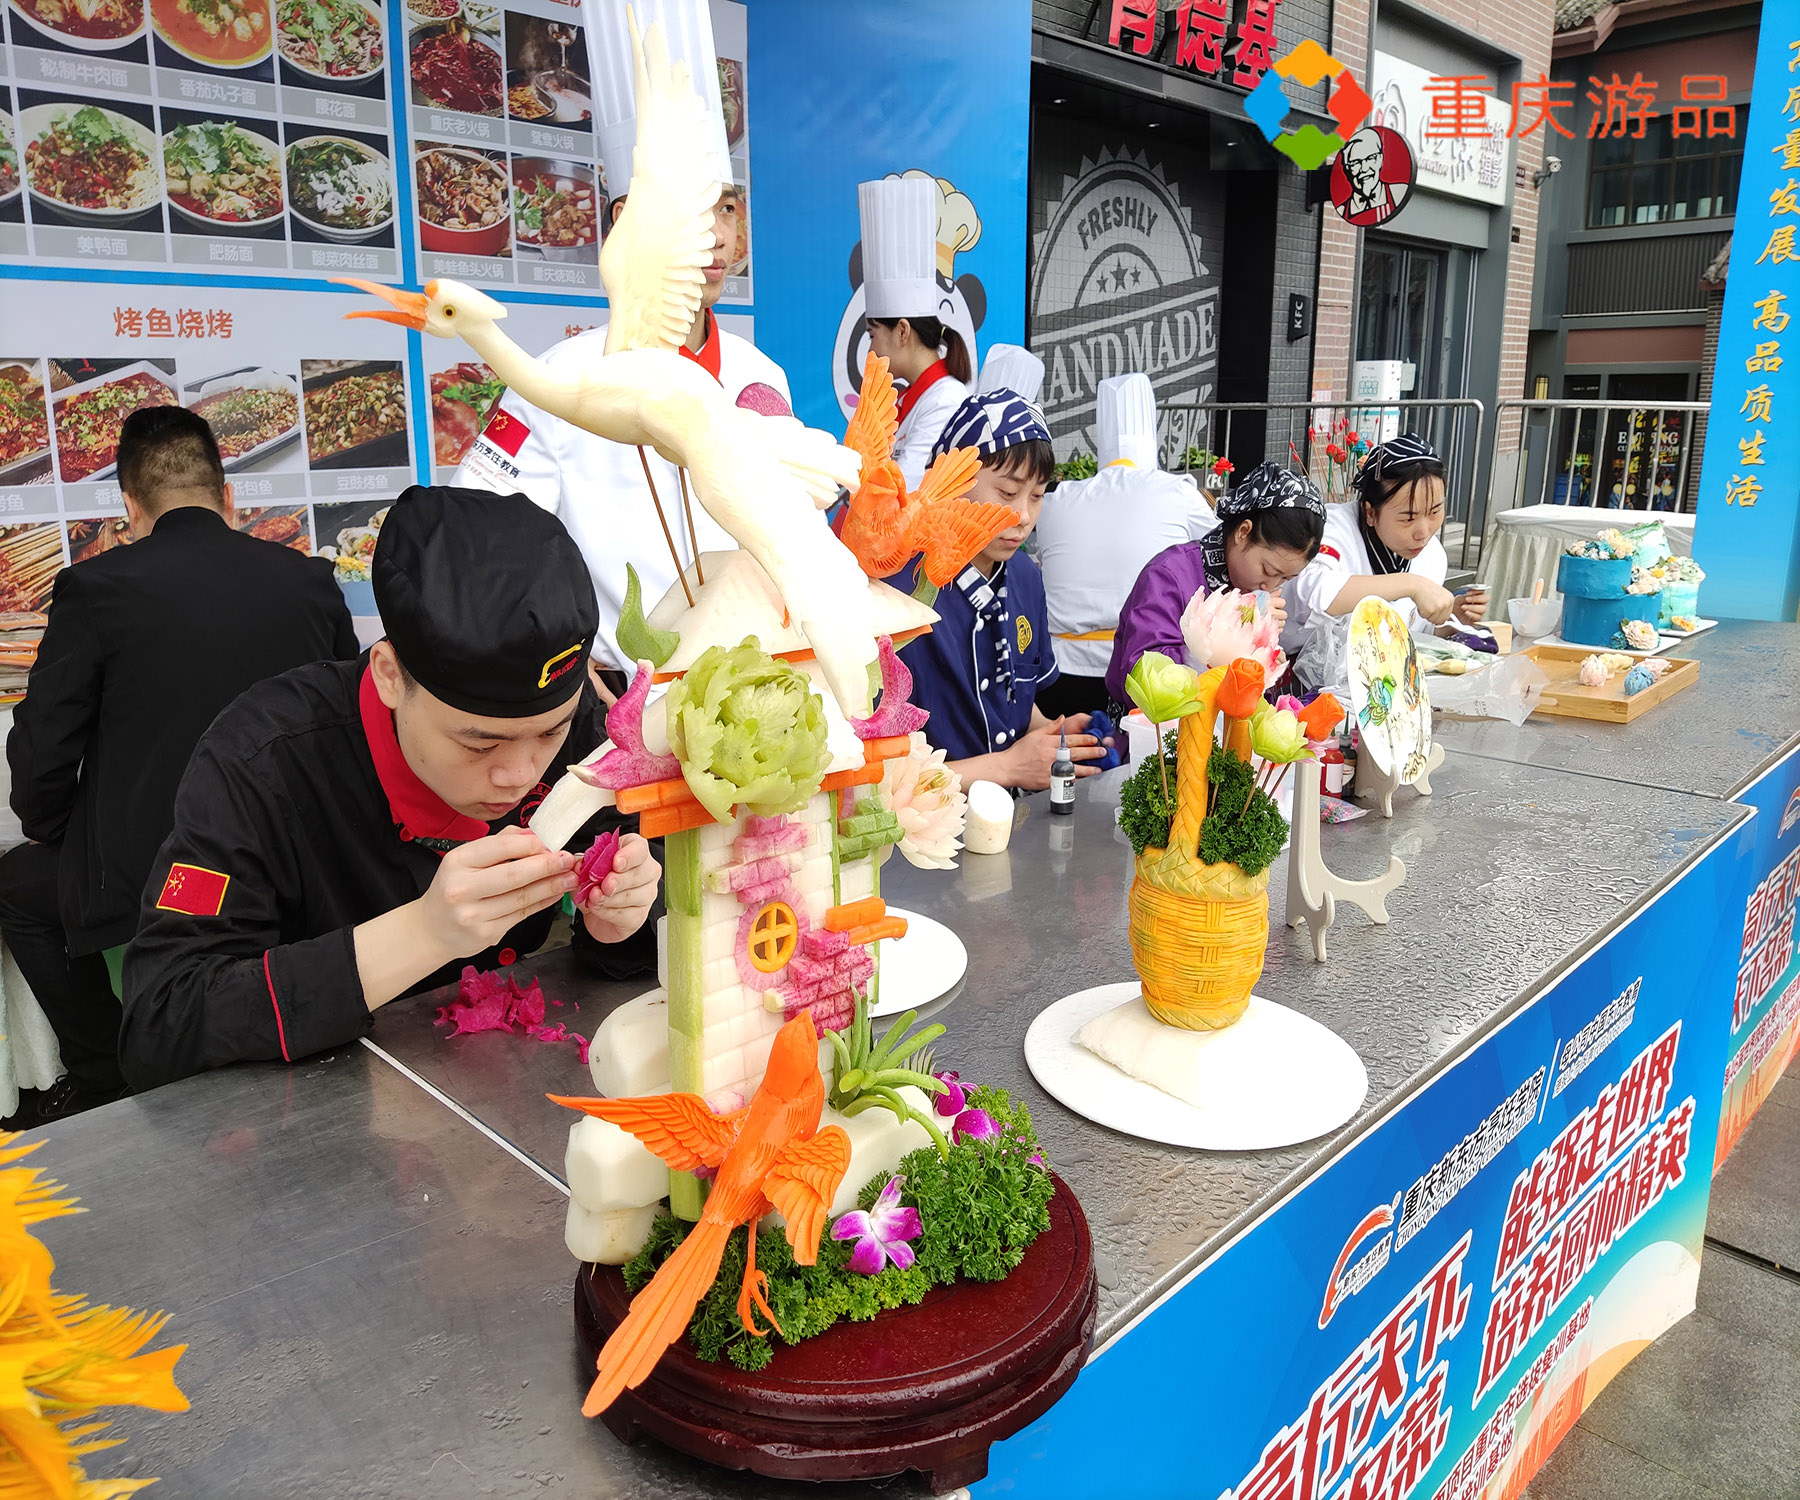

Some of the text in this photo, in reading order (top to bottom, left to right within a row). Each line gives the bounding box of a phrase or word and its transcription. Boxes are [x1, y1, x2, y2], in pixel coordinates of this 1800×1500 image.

[40, 57, 128, 88] 秘制牛肉面
[180, 79, 256, 105] 番茄丸子面
[430, 114, 490, 139] 重庆老火锅
[1077, 196, 1158, 251] FRESHLY
[77, 235, 128, 256] 姜鸭面
[209, 243, 253, 262] 肥肠面
[311, 249, 379, 270] 酸菜肉丝面
[533, 266, 586, 285] 重庆烧鸡公
[113, 306, 233, 340] 烤鱼烧烤
[1294, 301, 1304, 328] KFC
[1726, 290, 1791, 508] 高品质生活
[337, 475, 389, 491] 豆豉烤鱼
[1401, 1070, 1543, 1229] 重庆新东方烹饪学院
[1396, 1201, 1442, 1250] CHONGQING
[1475, 1102, 1692, 1400] 培养厨师精英
